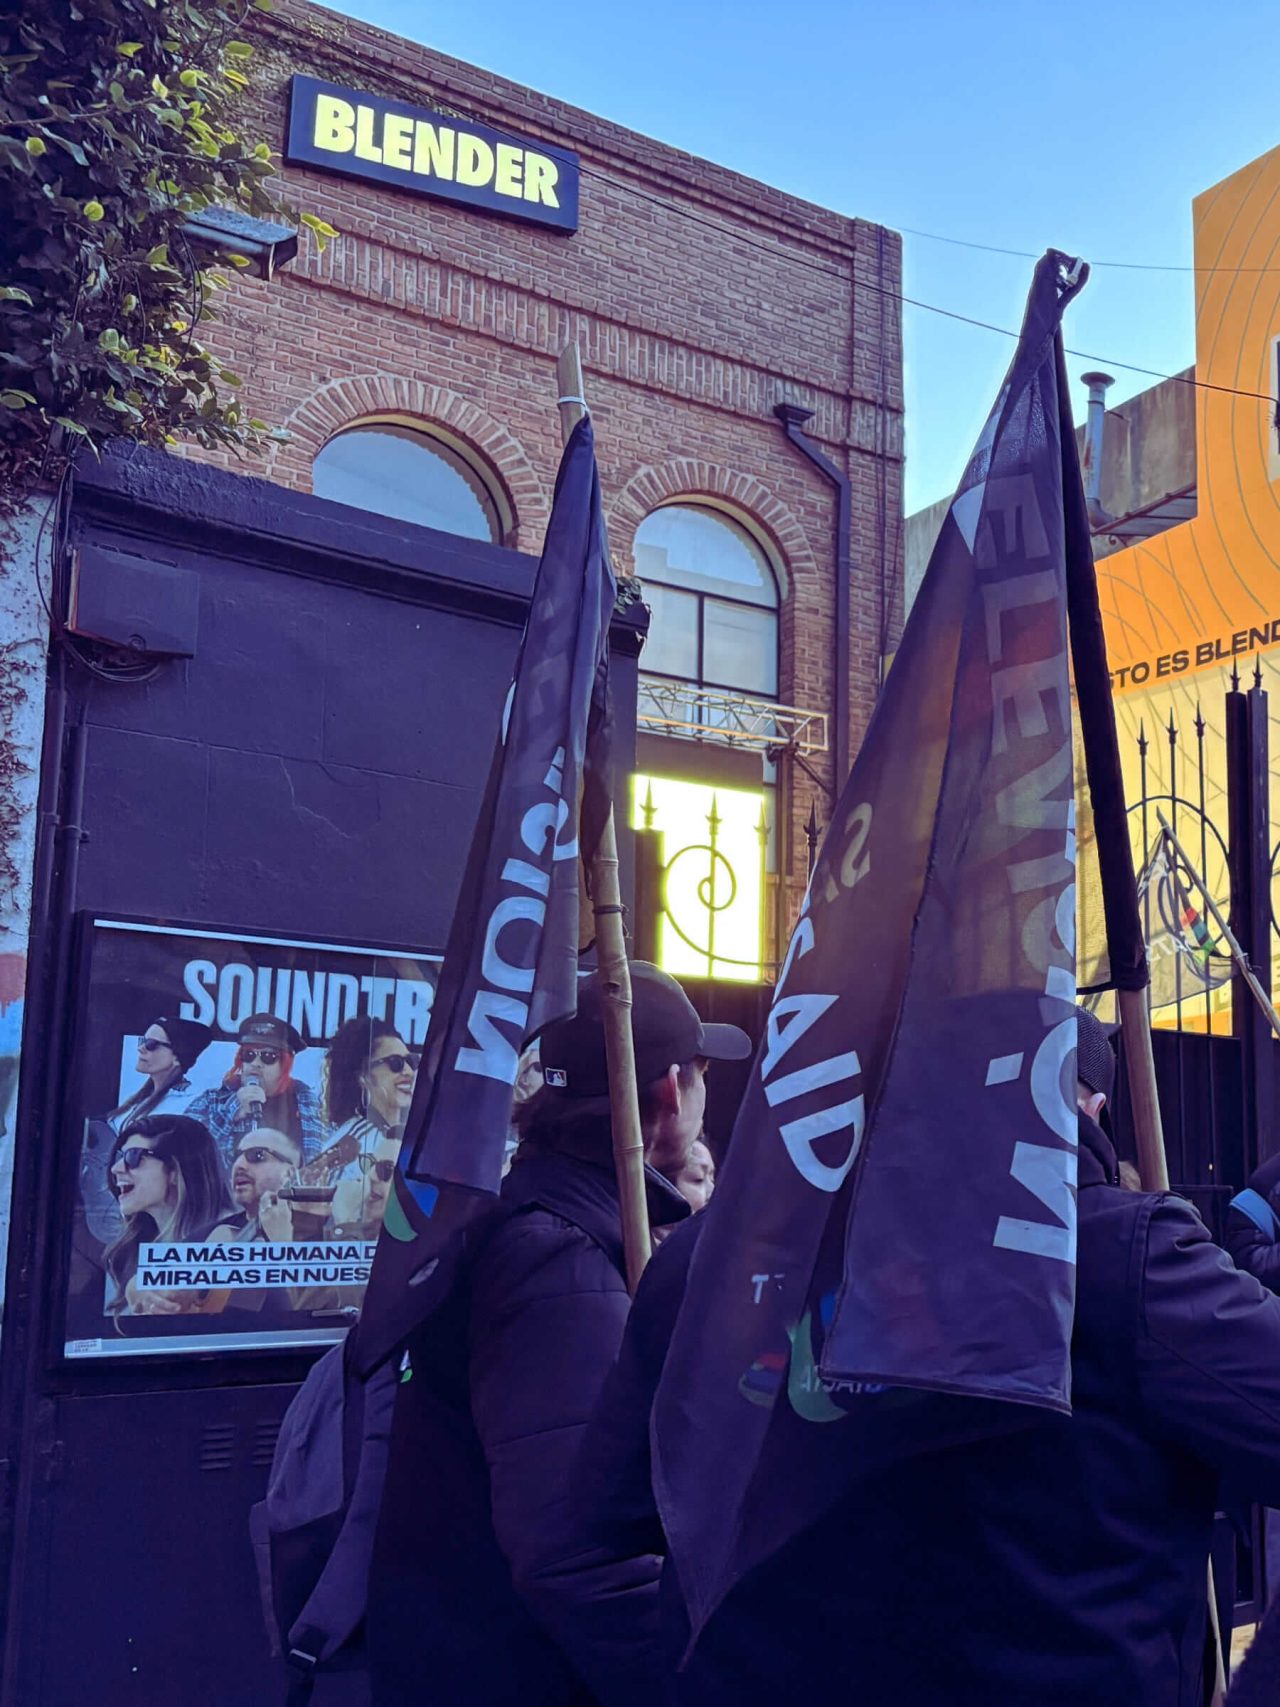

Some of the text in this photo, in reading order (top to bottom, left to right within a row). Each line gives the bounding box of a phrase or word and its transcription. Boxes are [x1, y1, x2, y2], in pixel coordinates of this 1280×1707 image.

[314, 94, 560, 208] BLENDER
[1156, 650, 1190, 678] ES
[180, 959, 434, 1045] SOUNDTR
[147, 1247, 181, 1263] LA
[186, 1244, 245, 1263] MÁS
[249, 1245, 361, 1263] HUMANA
[142, 1268, 261, 1286] MIRALAS
[265, 1268, 299, 1284] EN
